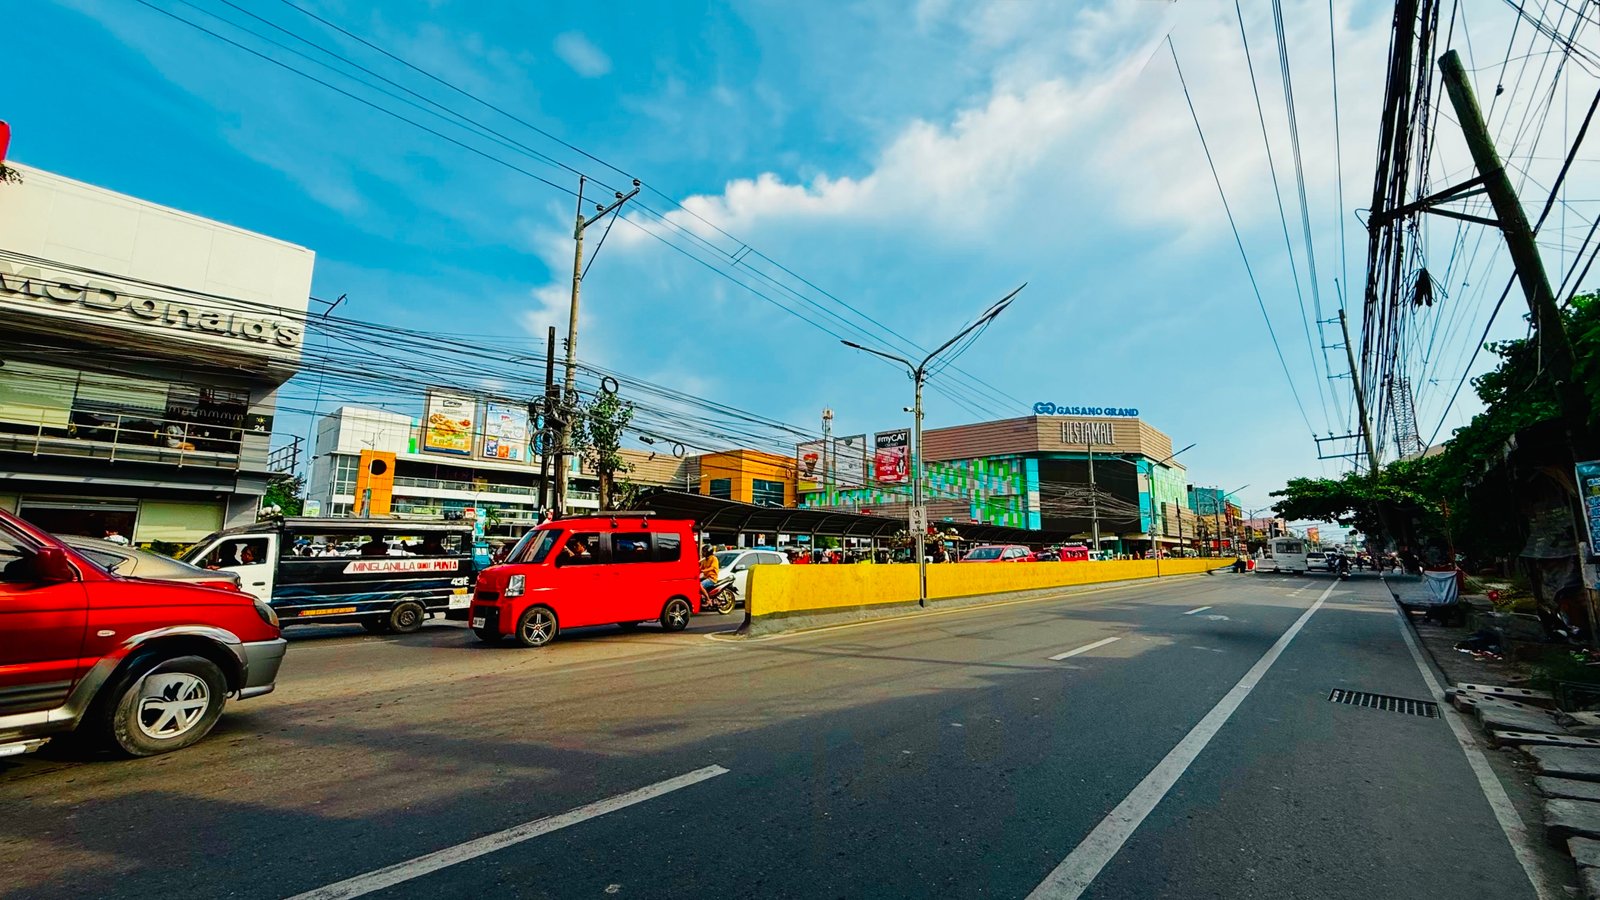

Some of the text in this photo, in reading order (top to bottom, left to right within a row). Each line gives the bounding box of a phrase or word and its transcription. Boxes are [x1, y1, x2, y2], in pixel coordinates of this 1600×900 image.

[0, 262, 299, 347] McDonald's
[1056, 406, 1103, 416] GAISANO
[1103, 407, 1139, 417] GRAND
[254, 424, 265, 432] 24
[877, 432, 907, 443] #myCAT
[352, 561, 416, 572] MINGLANILLA
[433, 560, 457, 570] PUNTA
